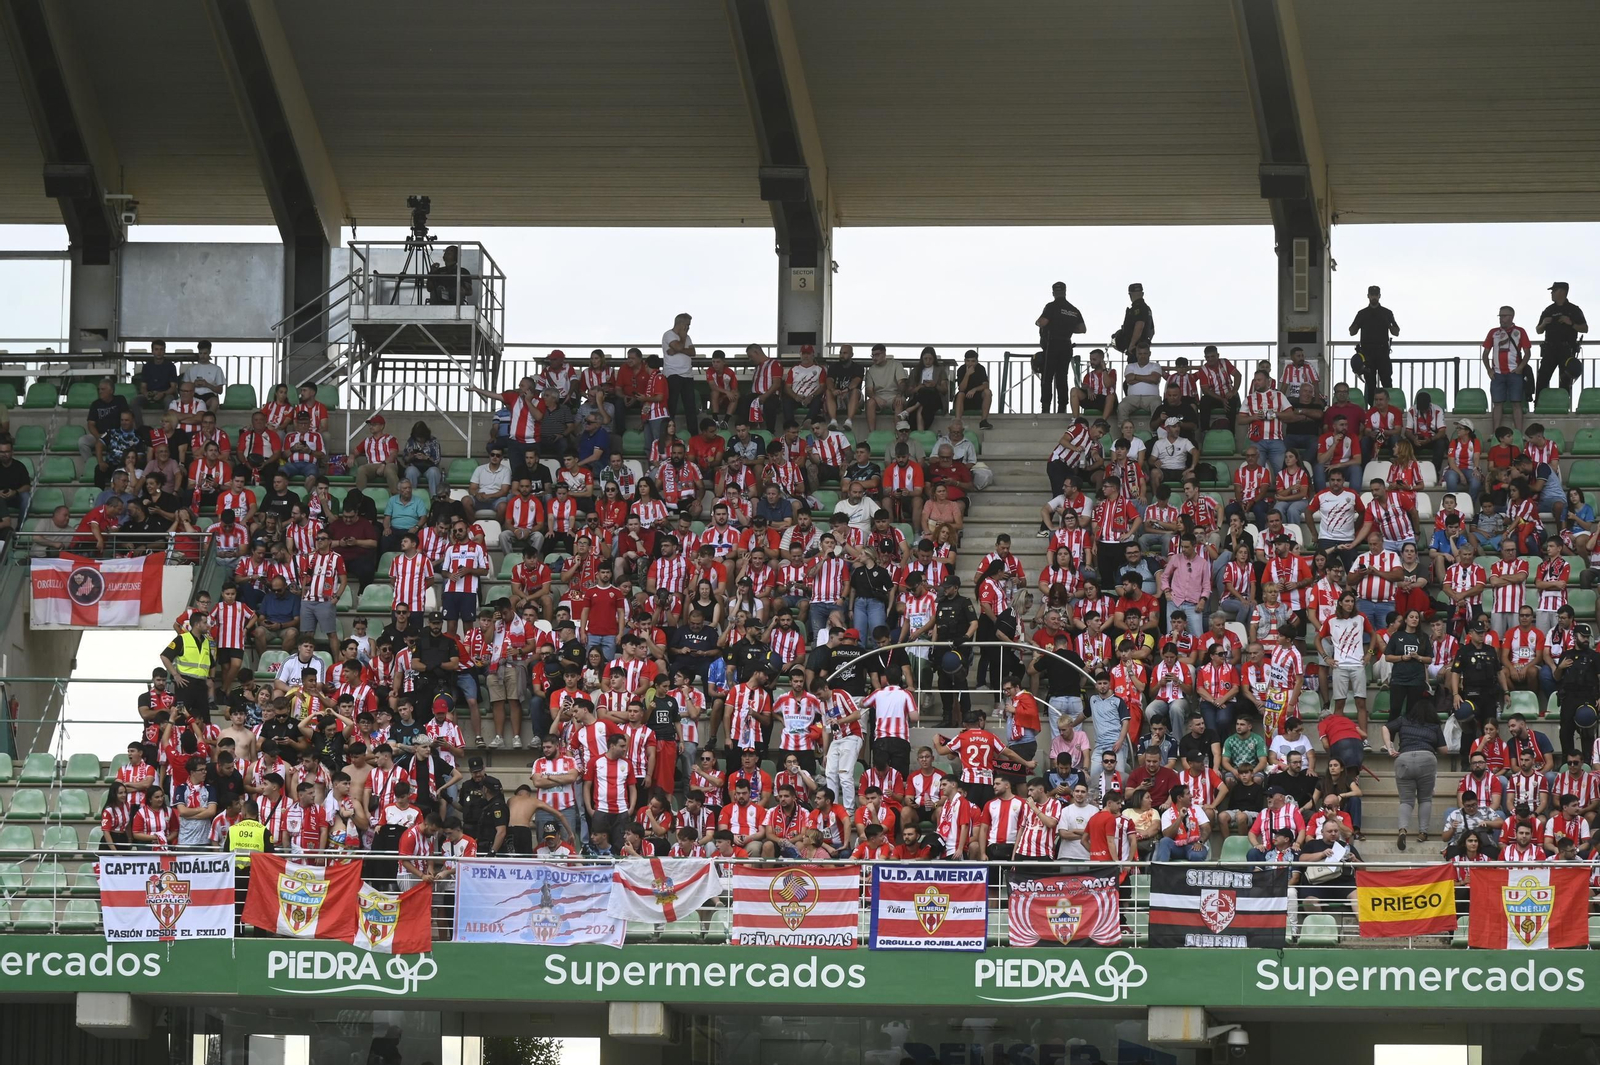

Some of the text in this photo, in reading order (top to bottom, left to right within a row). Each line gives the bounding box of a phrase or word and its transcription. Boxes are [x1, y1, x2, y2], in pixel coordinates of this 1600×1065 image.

[799, 277, 807, 288] 3
[684, 633, 708, 641] ITALIA
[966, 744, 991, 767] 27
[105, 858, 230, 875] CAPITAL INDÁLICA
[472, 865, 507, 880] PEÑA
[881, 869, 984, 882] U.D. ALMERIA
[1186, 868, 1253, 888] SIEMPRE
[1009, 879, 1045, 892] PEÑA
[1370, 893, 1442, 912] PRIEGO
[1508, 891, 1548, 900] U D
[886, 905, 906, 914] Peña
[108, 928, 226, 938] PASIÓN DESDE EL EXILIO
[465, 922, 504, 933] ALBOX
[585, 925, 615, 935] 2024
[740, 932, 852, 947] PEÑA MILHOJAS
[1, 945, 161, 977] ercados
[544, 953, 866, 992] Supermercados
[1255, 958, 1585, 997] Supermercados
